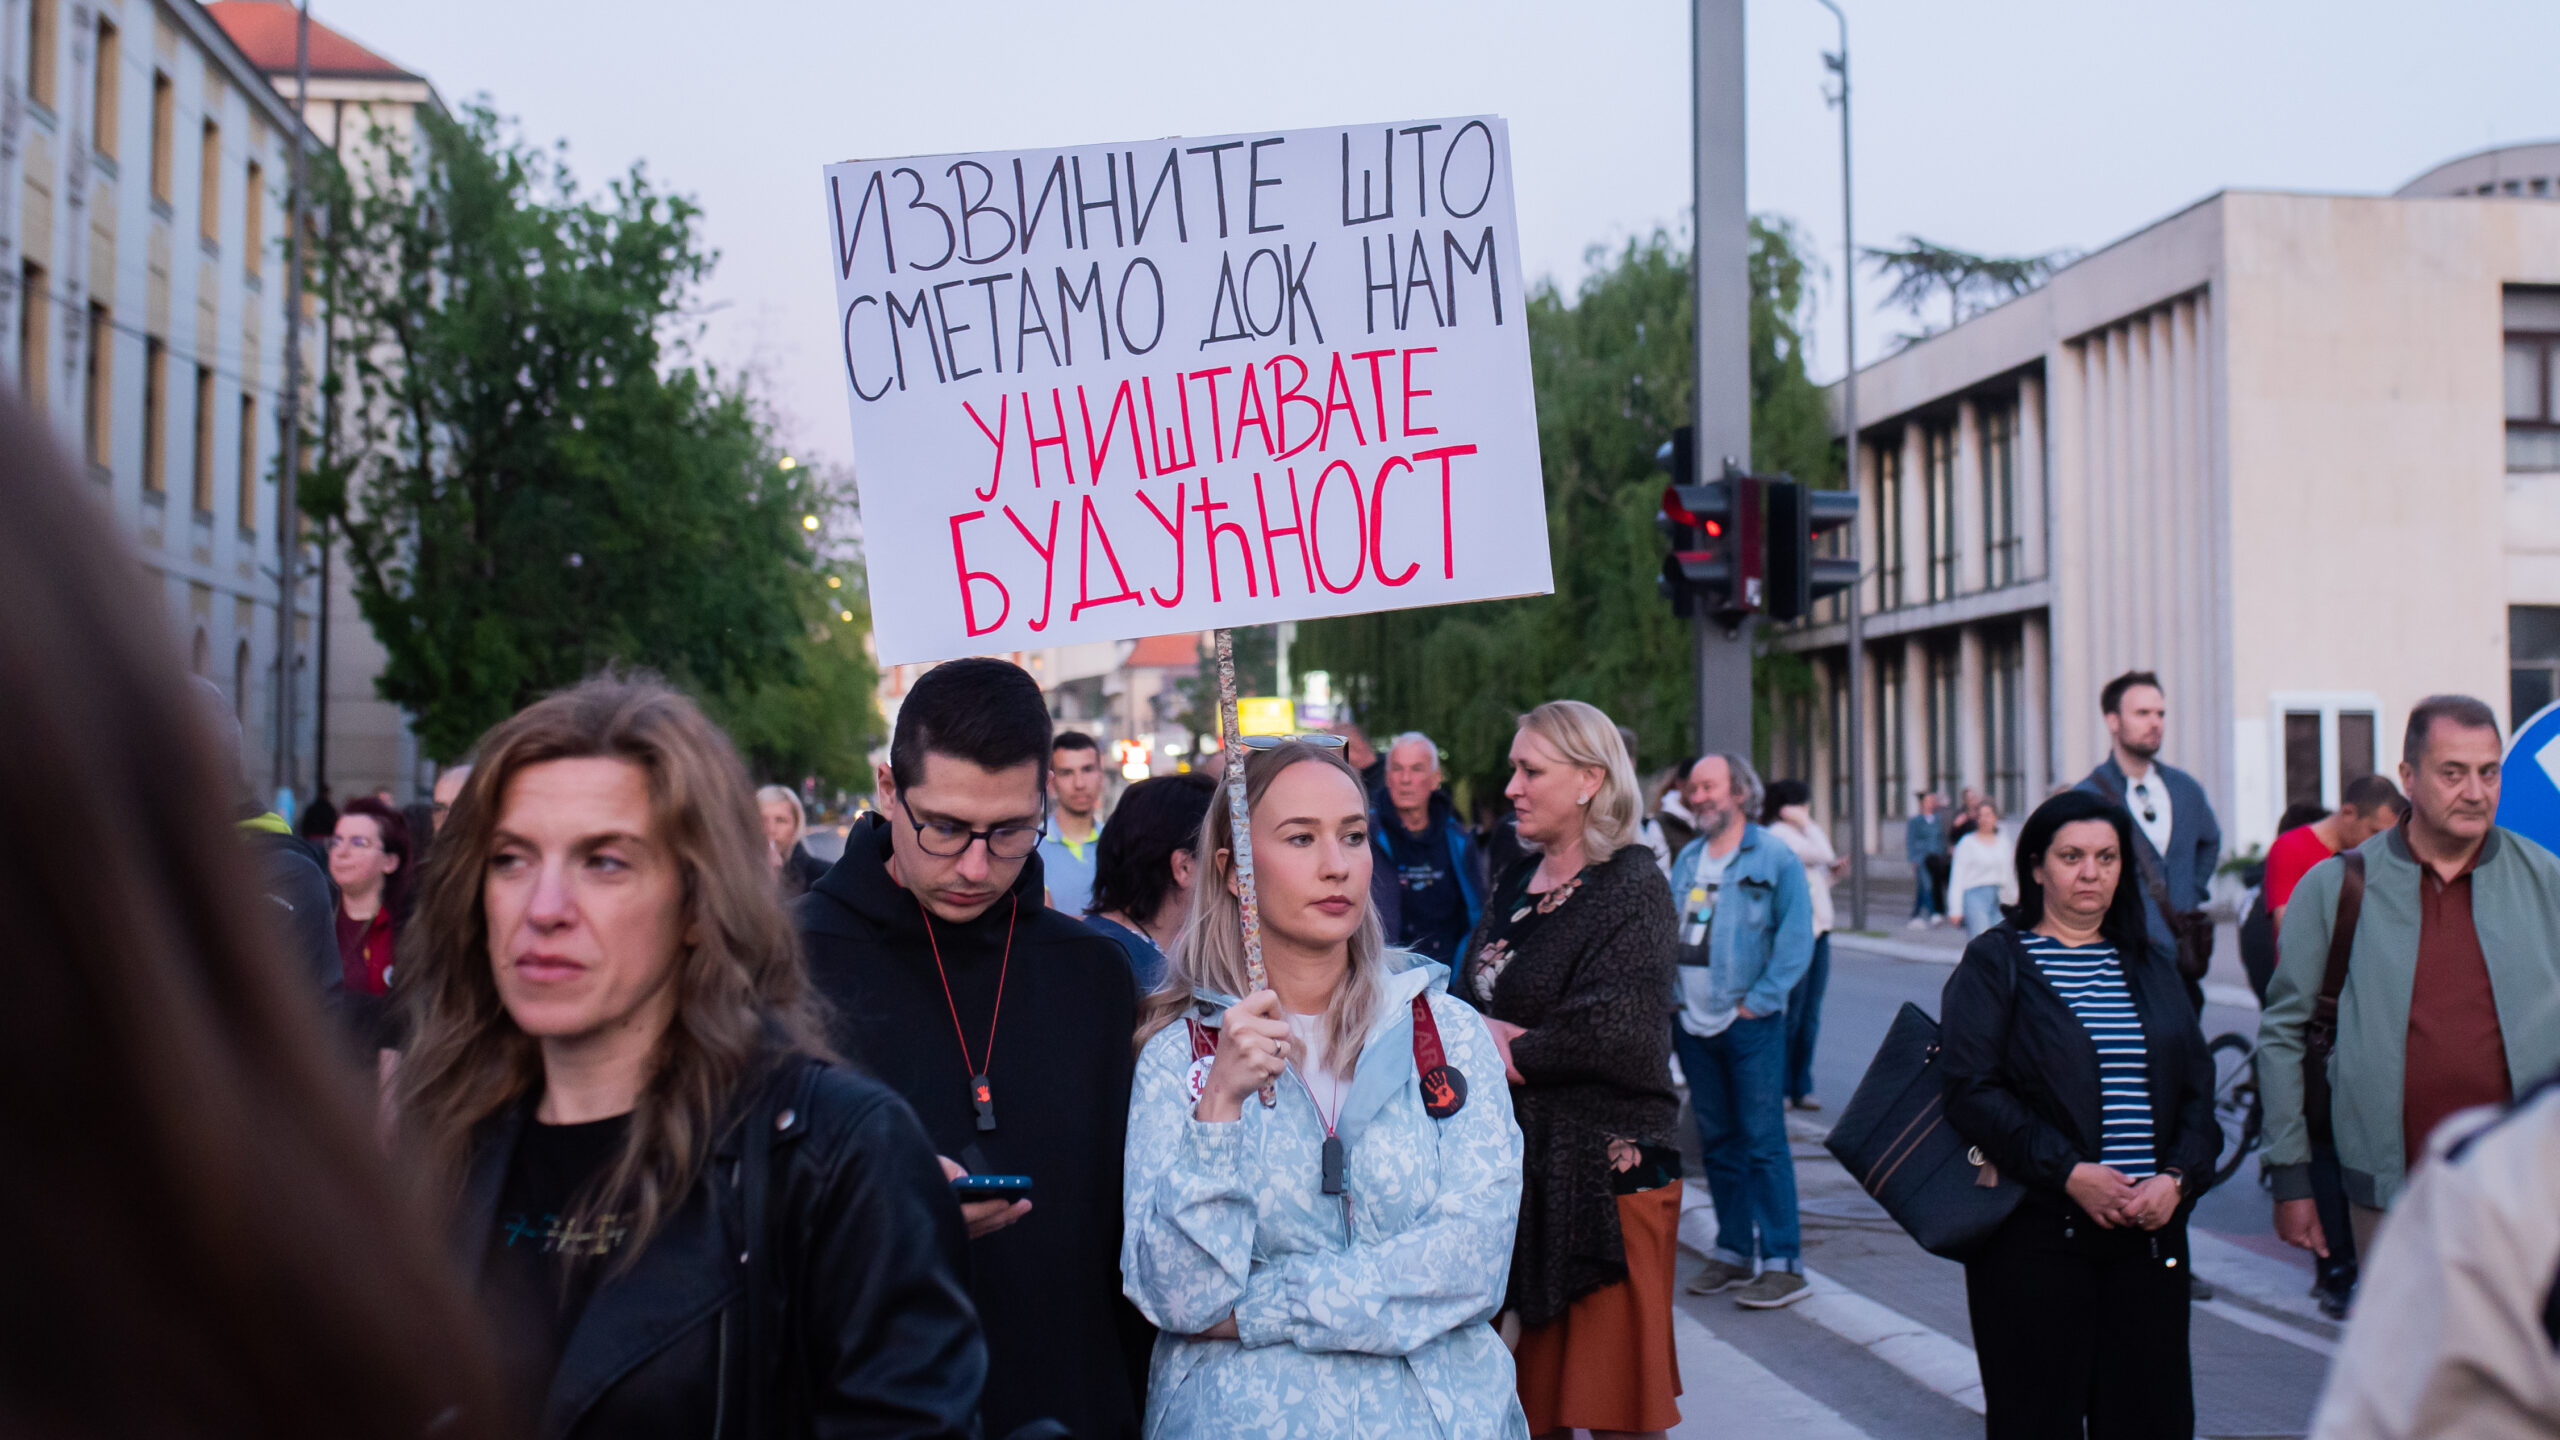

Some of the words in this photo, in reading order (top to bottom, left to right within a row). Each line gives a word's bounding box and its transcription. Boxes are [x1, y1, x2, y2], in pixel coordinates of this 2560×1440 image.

[831, 136, 1285, 280] ИЗВИНИТЕ
[1341, 120, 1495, 227] ШТО
[844, 256, 1165, 402] СМЕТАМО
[1199, 241, 1325, 351] ДОК
[1362, 225, 1503, 335] НАМ
[962, 346, 1439, 502] УНИШТАВАТЕ
[949, 443, 1478, 638] БУДУЋНОСТ
